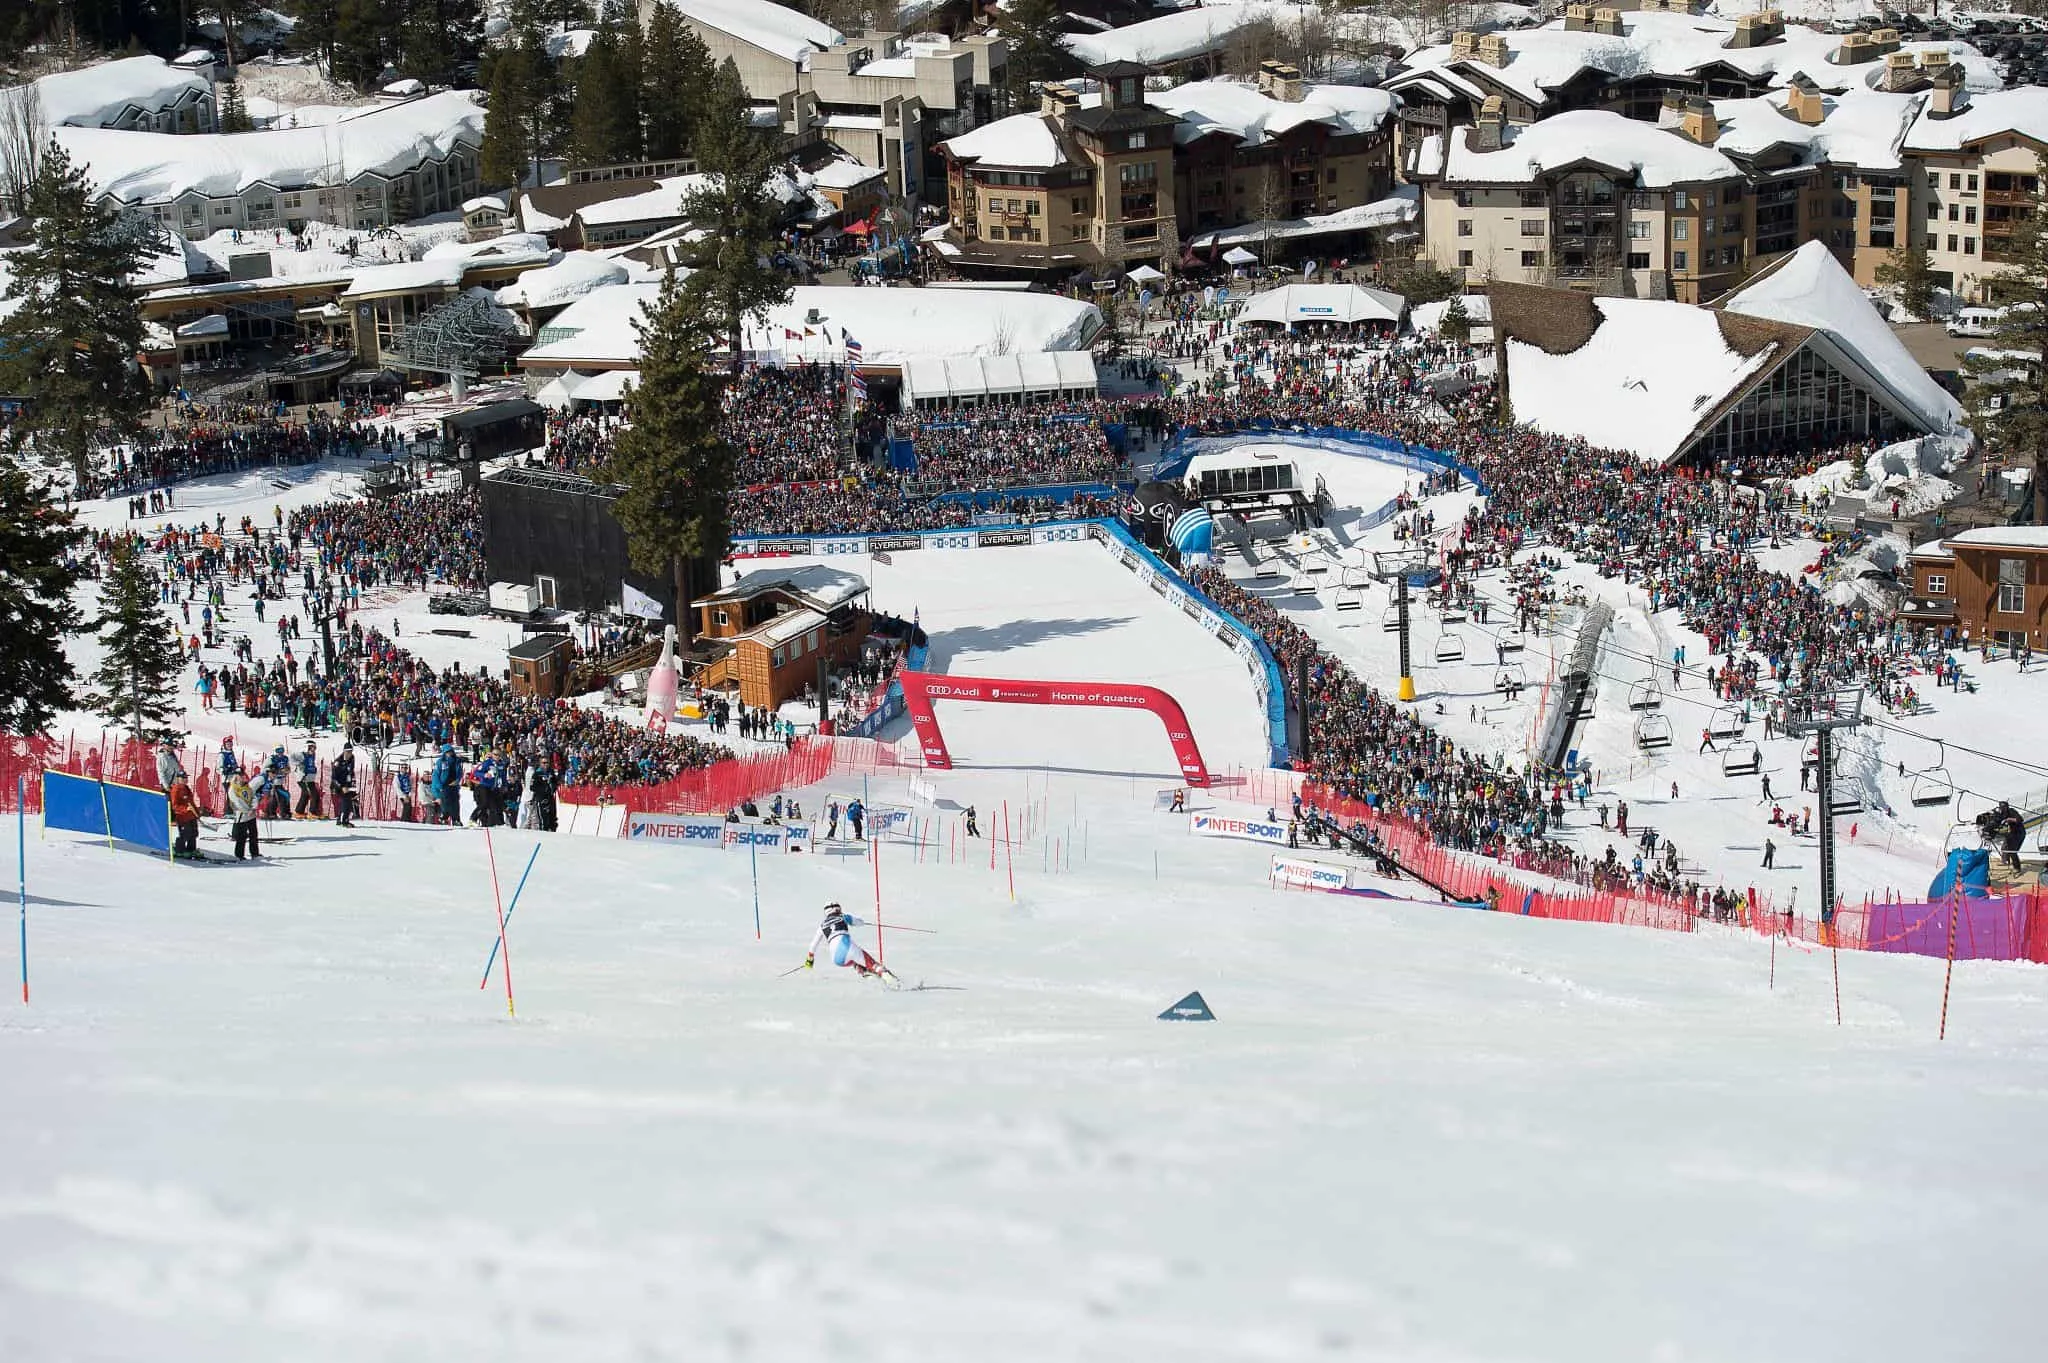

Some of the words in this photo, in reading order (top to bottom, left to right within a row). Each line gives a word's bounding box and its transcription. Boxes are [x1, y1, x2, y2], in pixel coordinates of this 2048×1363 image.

[870, 540, 920, 550] FLYERALARM
[979, 533, 1030, 545] FLYERALARM
[759, 544, 809, 552] FLYERALARM
[953, 688, 980, 696] Audi
[1052, 692, 1085, 701] Home
[1102, 696, 1146, 704] quattro
[646, 823, 721, 839] INTERSPORT
[1208, 818, 1285, 839] INTERSPORT
[1284, 864, 1343, 884] INTERSPORT
